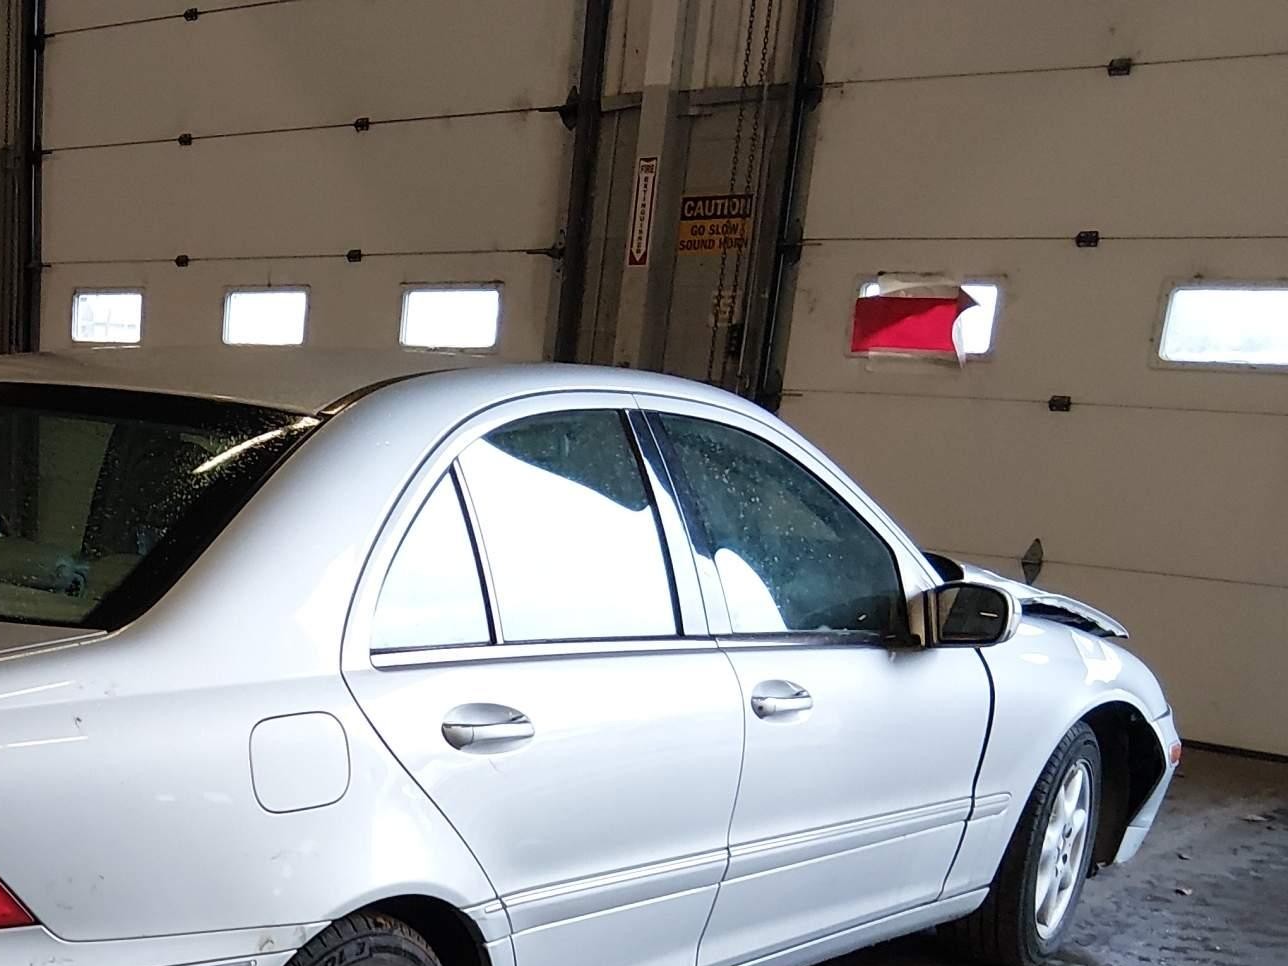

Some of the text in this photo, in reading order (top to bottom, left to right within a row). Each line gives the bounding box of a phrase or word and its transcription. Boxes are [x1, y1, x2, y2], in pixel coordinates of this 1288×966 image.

[640, 164, 655, 174] FIRE
[684, 198, 752, 217] CAUTION
[635, 175, 649, 255] EXTINGUISHER
[690, 223, 740, 237] GO SLOW
[678, 239, 715, 252] SOUND
